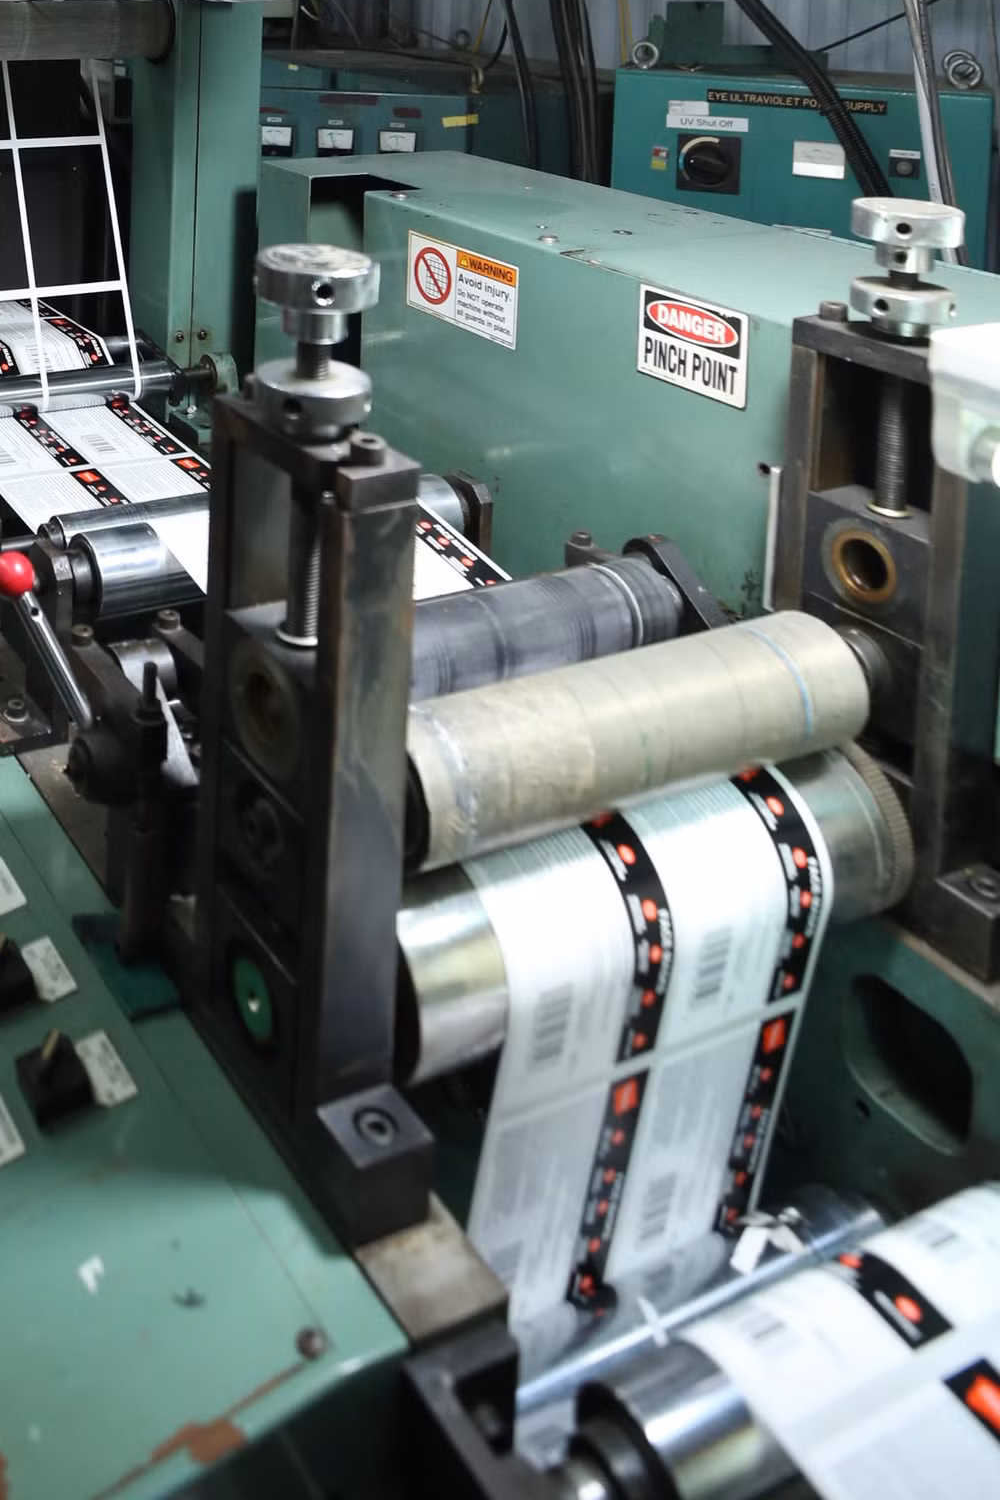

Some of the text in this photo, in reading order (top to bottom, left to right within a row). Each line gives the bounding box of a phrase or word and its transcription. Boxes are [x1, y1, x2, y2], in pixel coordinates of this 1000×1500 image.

[708, 91, 729, 102] EYE
[730, 92, 800, 107] ULTRAVIOLET
[844, 101, 886, 113] SUPPLY
[680, 118, 734, 128] UV Shut Off
[458, 273, 482, 290] Avoid
[469, 257, 513, 283] WARNING
[456, 299, 506, 323] machine without
[457, 289, 505, 313] Do NOT operate
[456, 309, 464, 317] all
[464, 312, 485, 326] guards
[486, 319, 493, 328] in
[657, 304, 727, 344] DANGER
[644, 336, 738, 395] PINCH POINT
